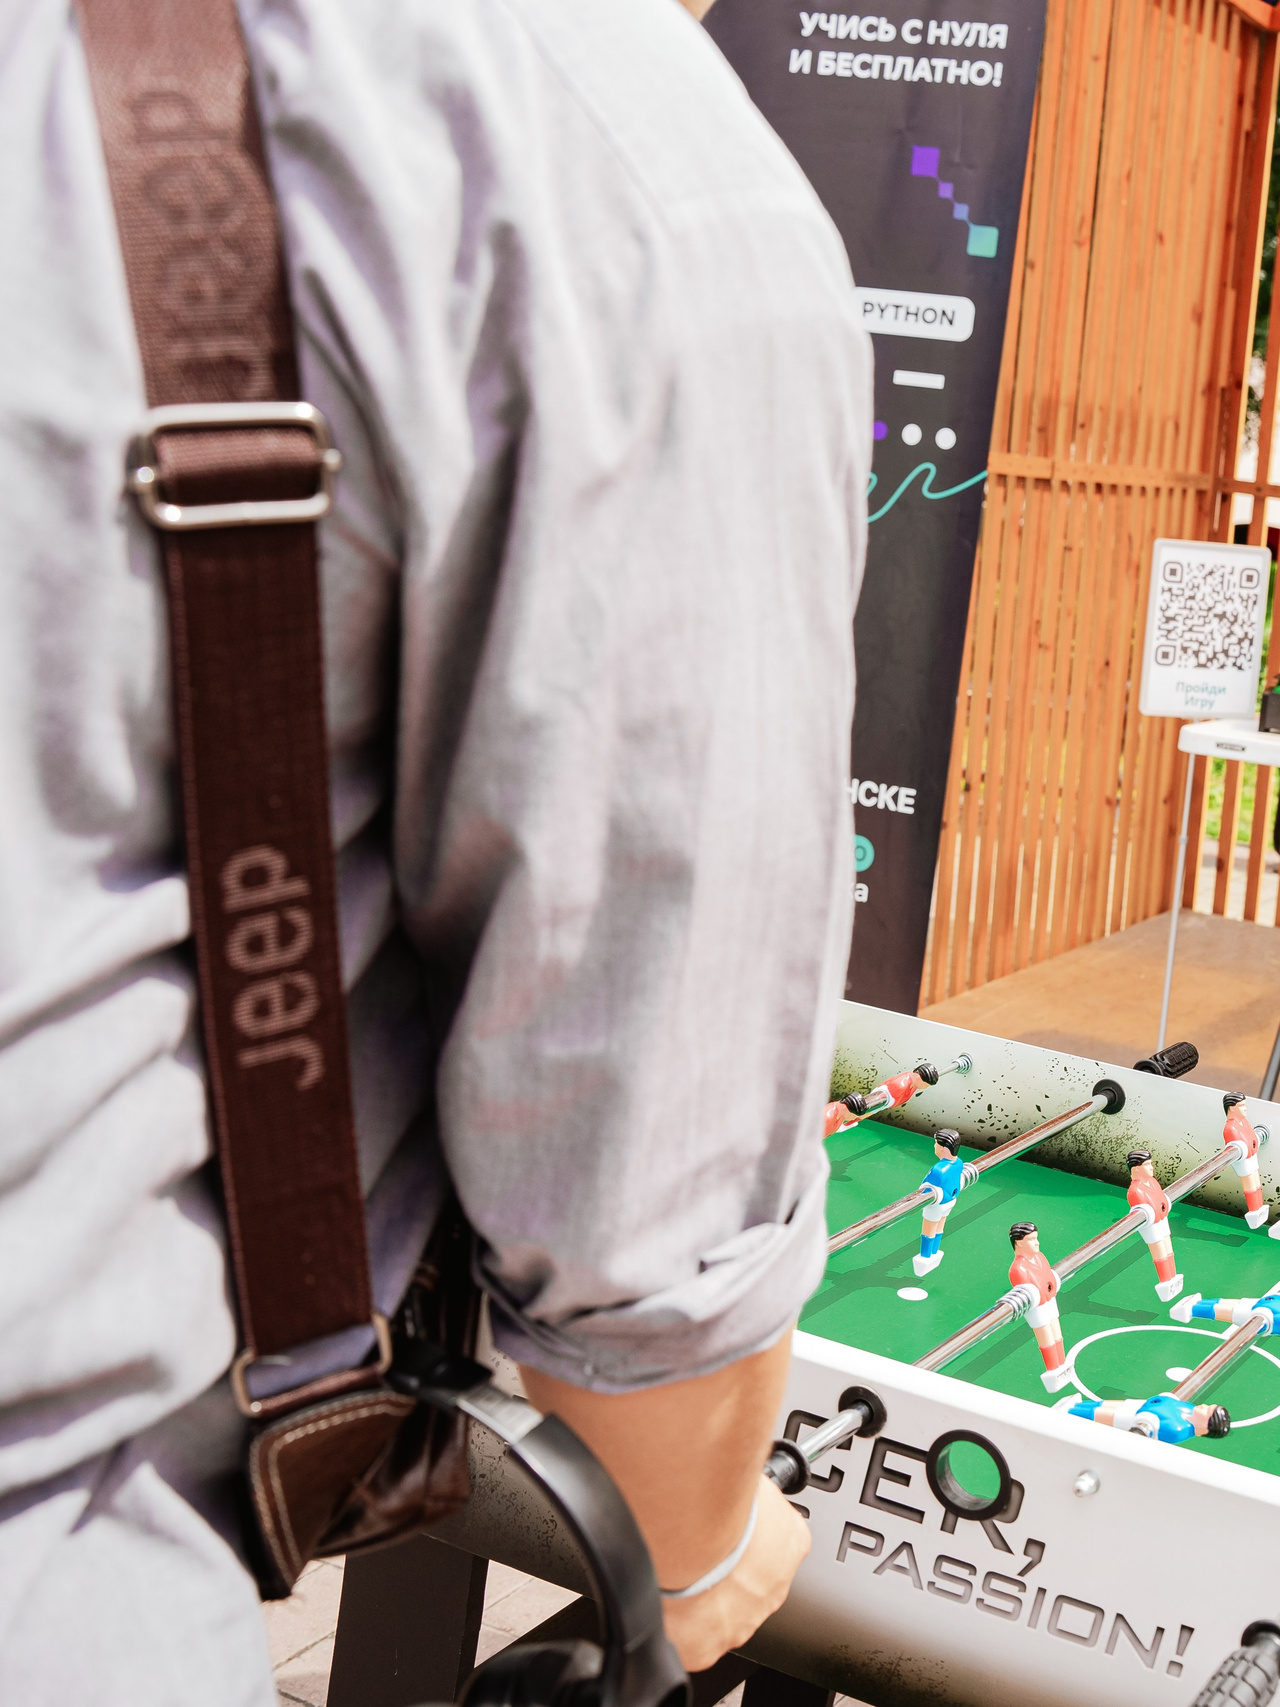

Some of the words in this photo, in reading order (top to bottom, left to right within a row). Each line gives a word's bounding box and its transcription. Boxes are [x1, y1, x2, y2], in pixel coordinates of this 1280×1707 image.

[799, 11, 897, 43] УЧИСЬ
[900, 19, 924, 44] С
[926, 20, 1009, 49] НУЛЯ
[788, 49, 812, 74] И
[817, 50, 1004, 87] БЕСПЛАТНО!
[862, 302, 956, 326] PYTHON
[1175, 681, 1227, 698] Пройди
[1184, 695, 1216, 710] Игру
[220, 843, 326, 1091] Jeep
[836, 1521, 1195, 1678] PASSION!
